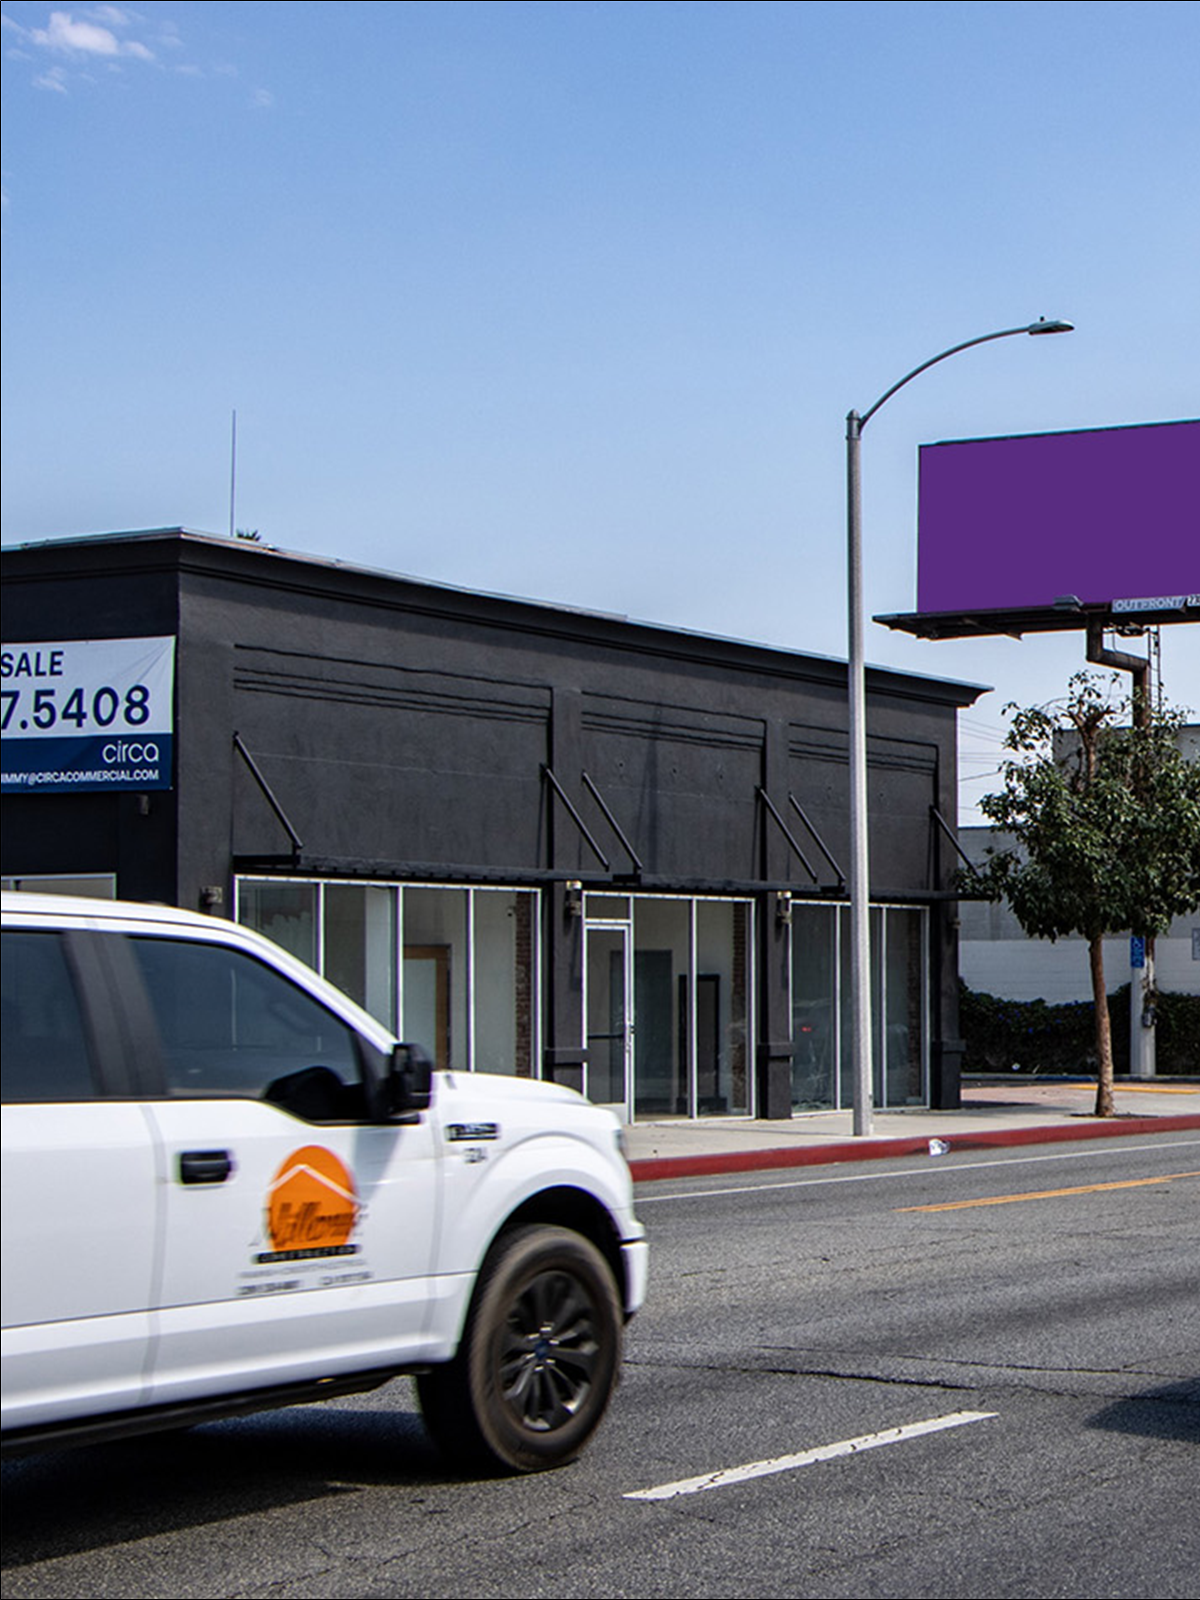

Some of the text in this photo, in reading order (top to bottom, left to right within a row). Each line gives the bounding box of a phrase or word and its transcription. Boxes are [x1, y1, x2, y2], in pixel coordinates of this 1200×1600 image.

[1, 651, 63, 677] SALE
[1, 685, 149, 730] 7.5408
[102, 741, 159, 763] circa
